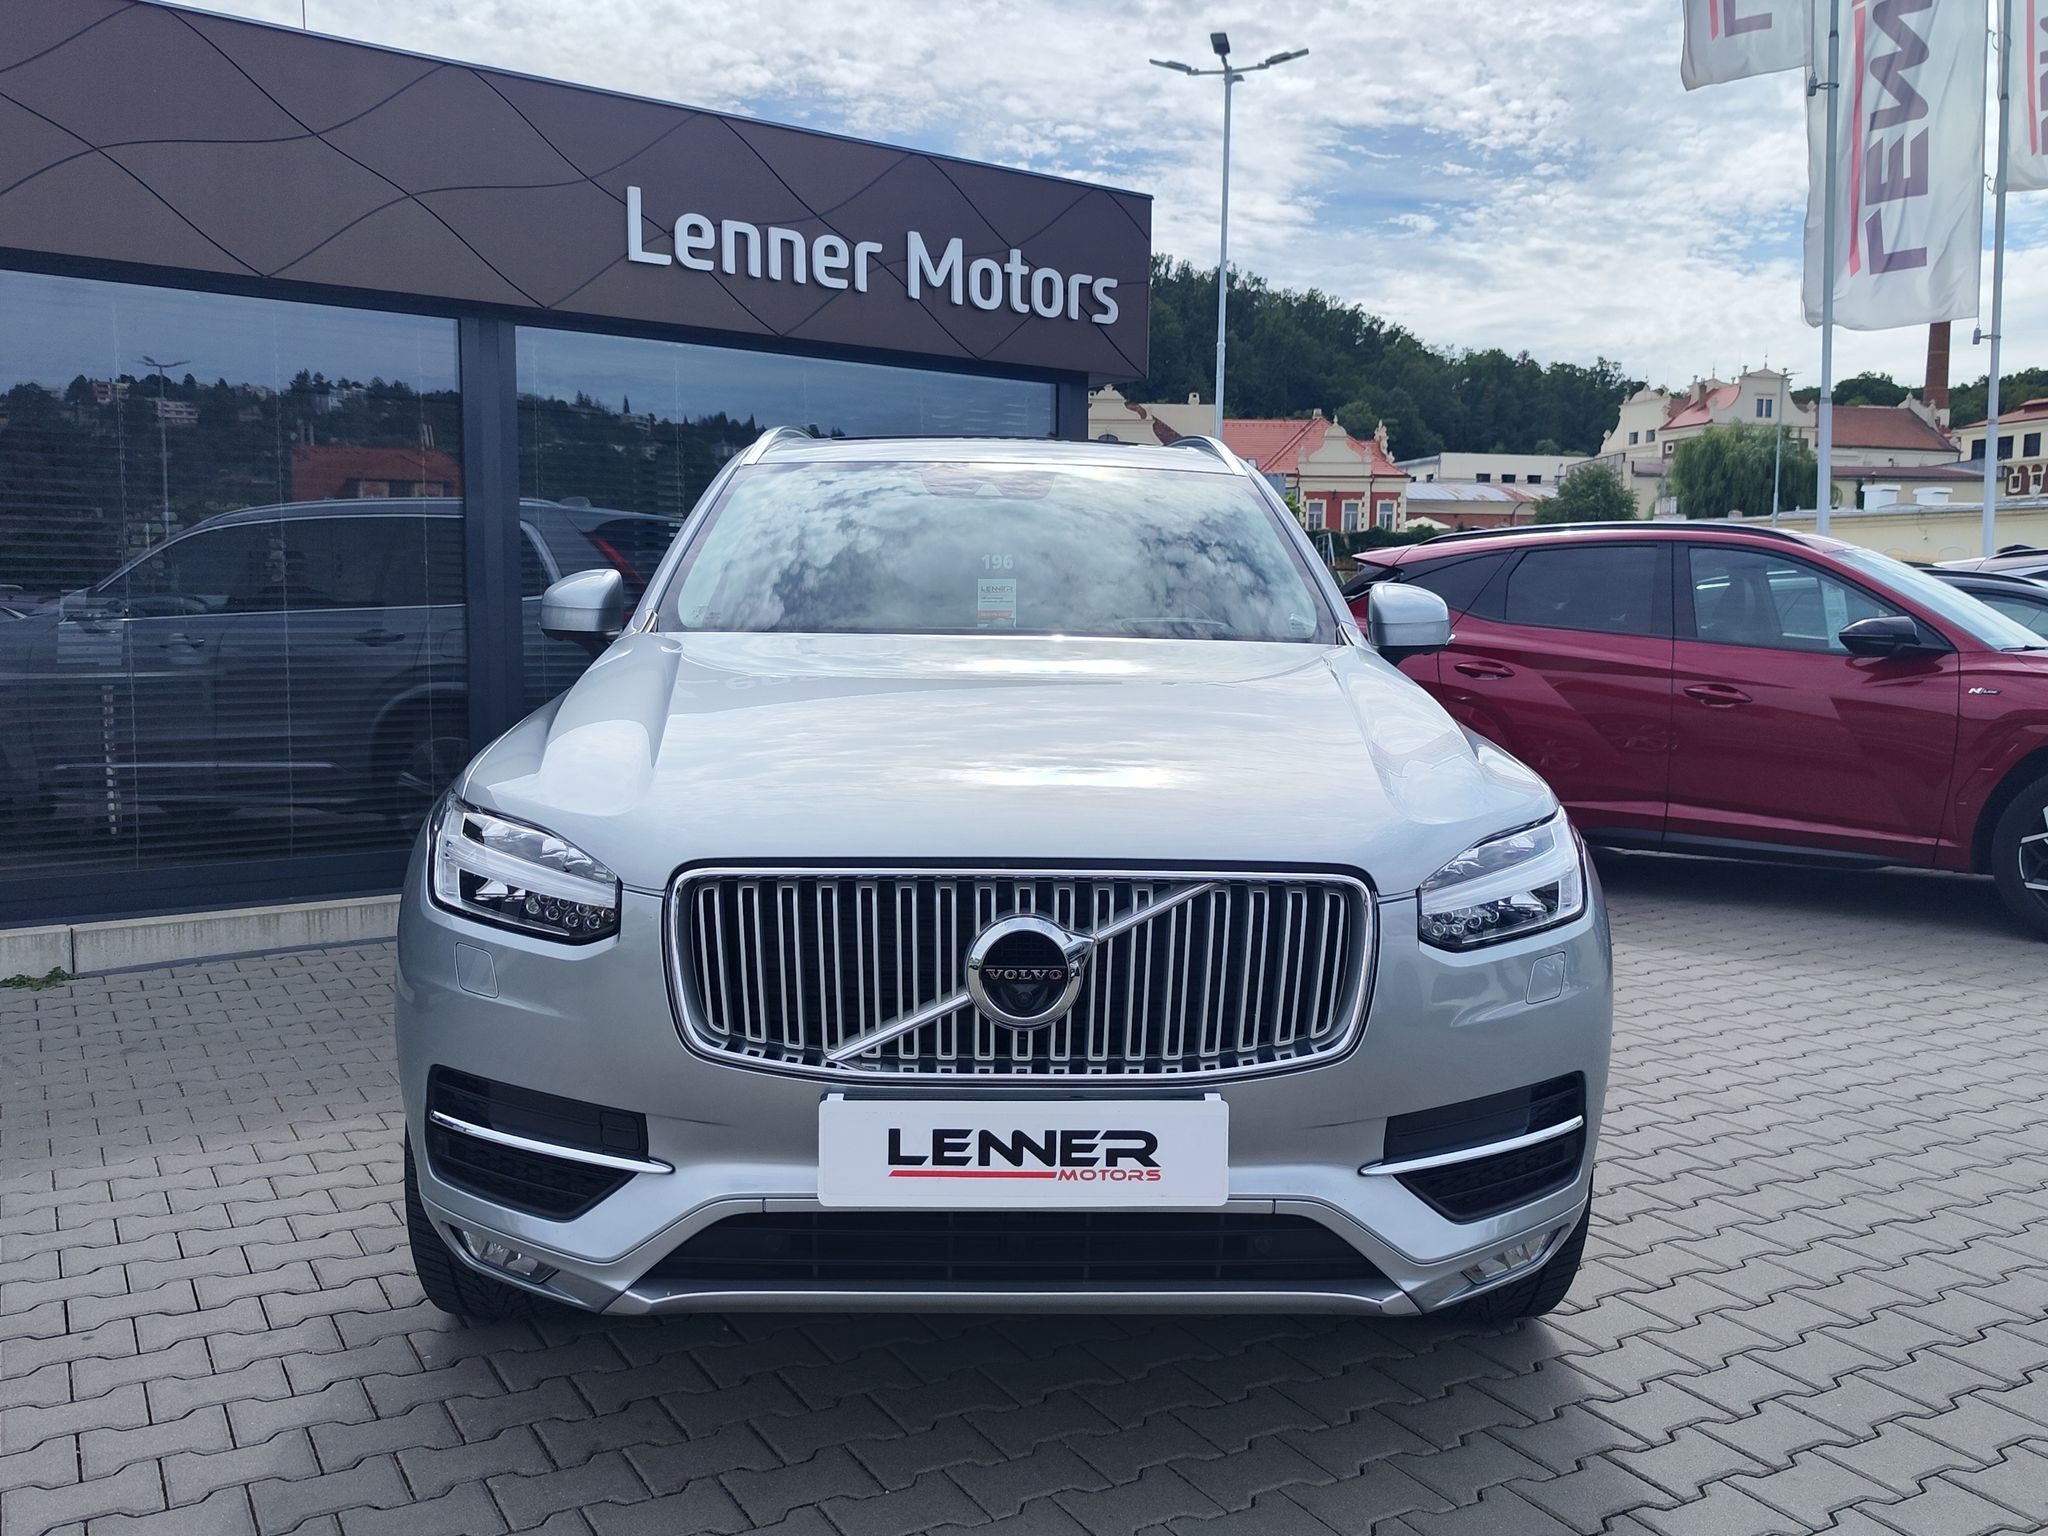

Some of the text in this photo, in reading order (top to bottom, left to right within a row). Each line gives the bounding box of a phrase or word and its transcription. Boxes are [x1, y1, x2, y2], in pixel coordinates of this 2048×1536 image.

[626, 185, 1120, 325] Lenner Motors
[981, 553, 1014, 570] 196
[985, 968, 1063, 981] VOLVO
[887, 1128, 1162, 1168] LENNER
[1057, 1169, 1162, 1182] MOTORS
